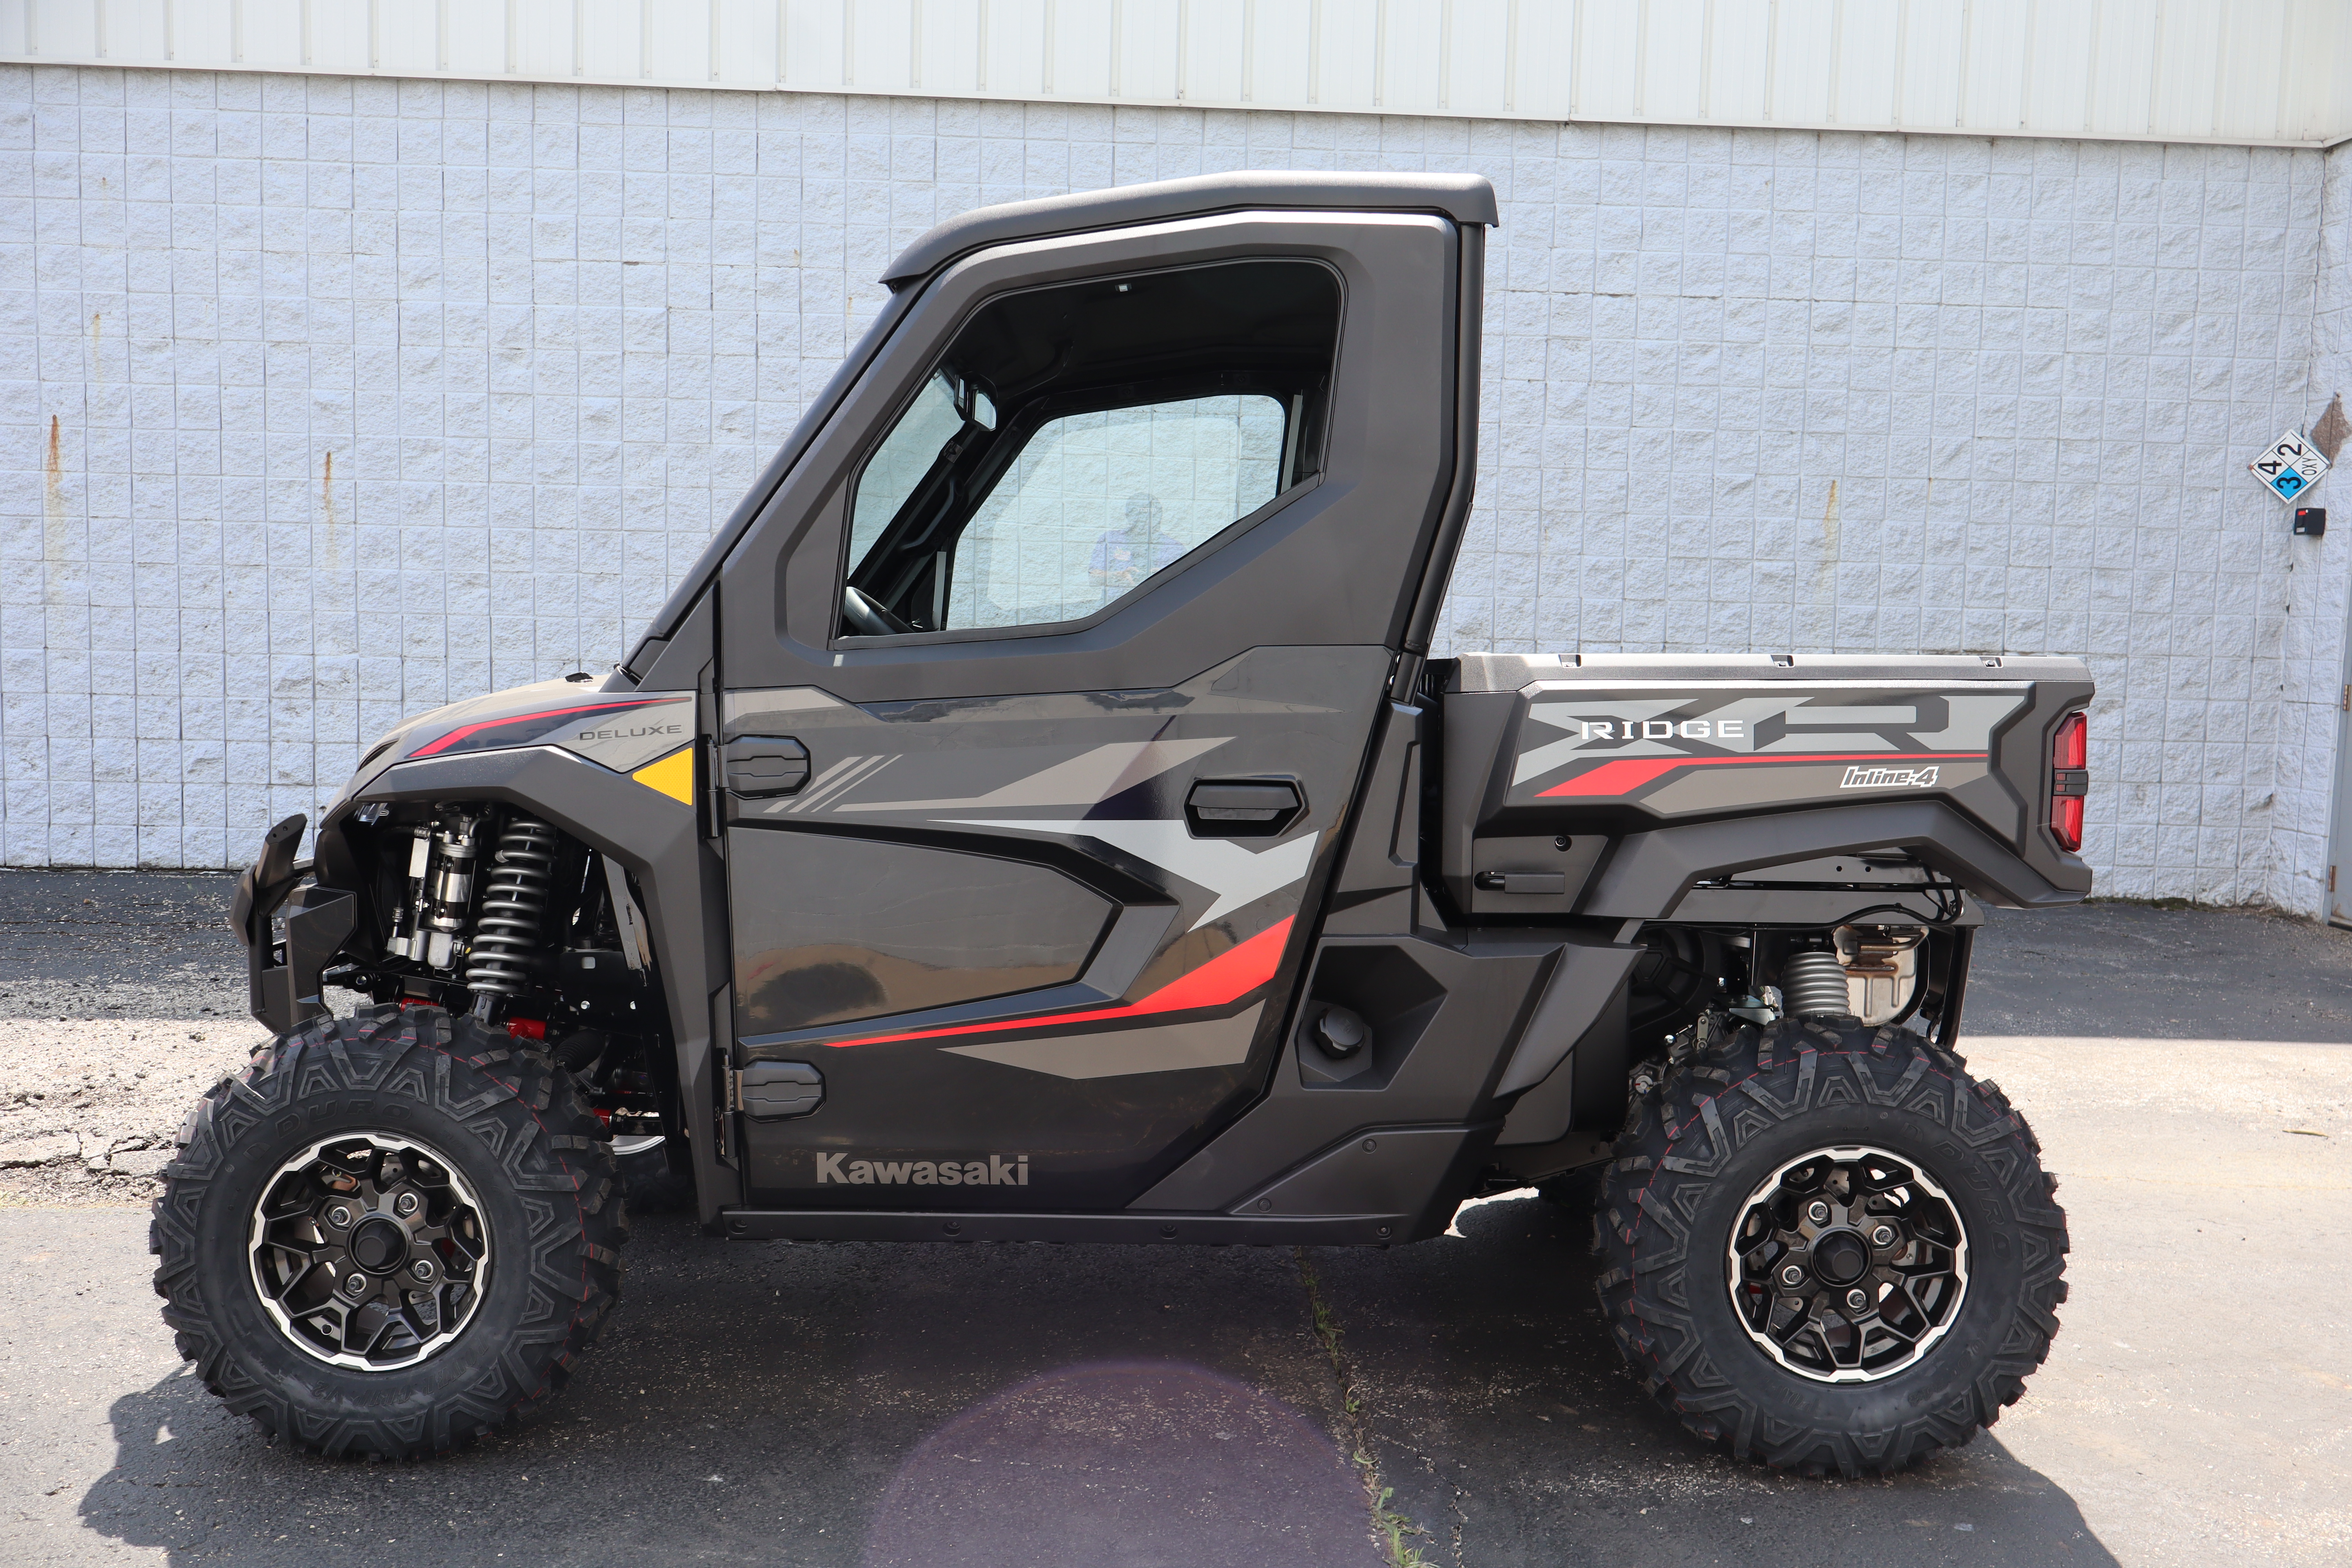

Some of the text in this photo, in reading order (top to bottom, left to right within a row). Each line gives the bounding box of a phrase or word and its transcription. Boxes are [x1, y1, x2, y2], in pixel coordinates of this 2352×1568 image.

[2278, 443, 2302, 456] 2
[2258, 460, 2282, 475] 4
[2302, 457, 2317, 476] OXY
[2276, 476, 2301, 490] 3
[579, 724, 682, 741] DELUXE
[1581, 720, 1744, 740] RIDGE
[1840, 766, 1940, 788] Inline-4
[275, 1099, 412, 1139] DURO
[816, 1152, 1028, 1186] Kawasaki
[1931, 1140, 2013, 1260] DURO
